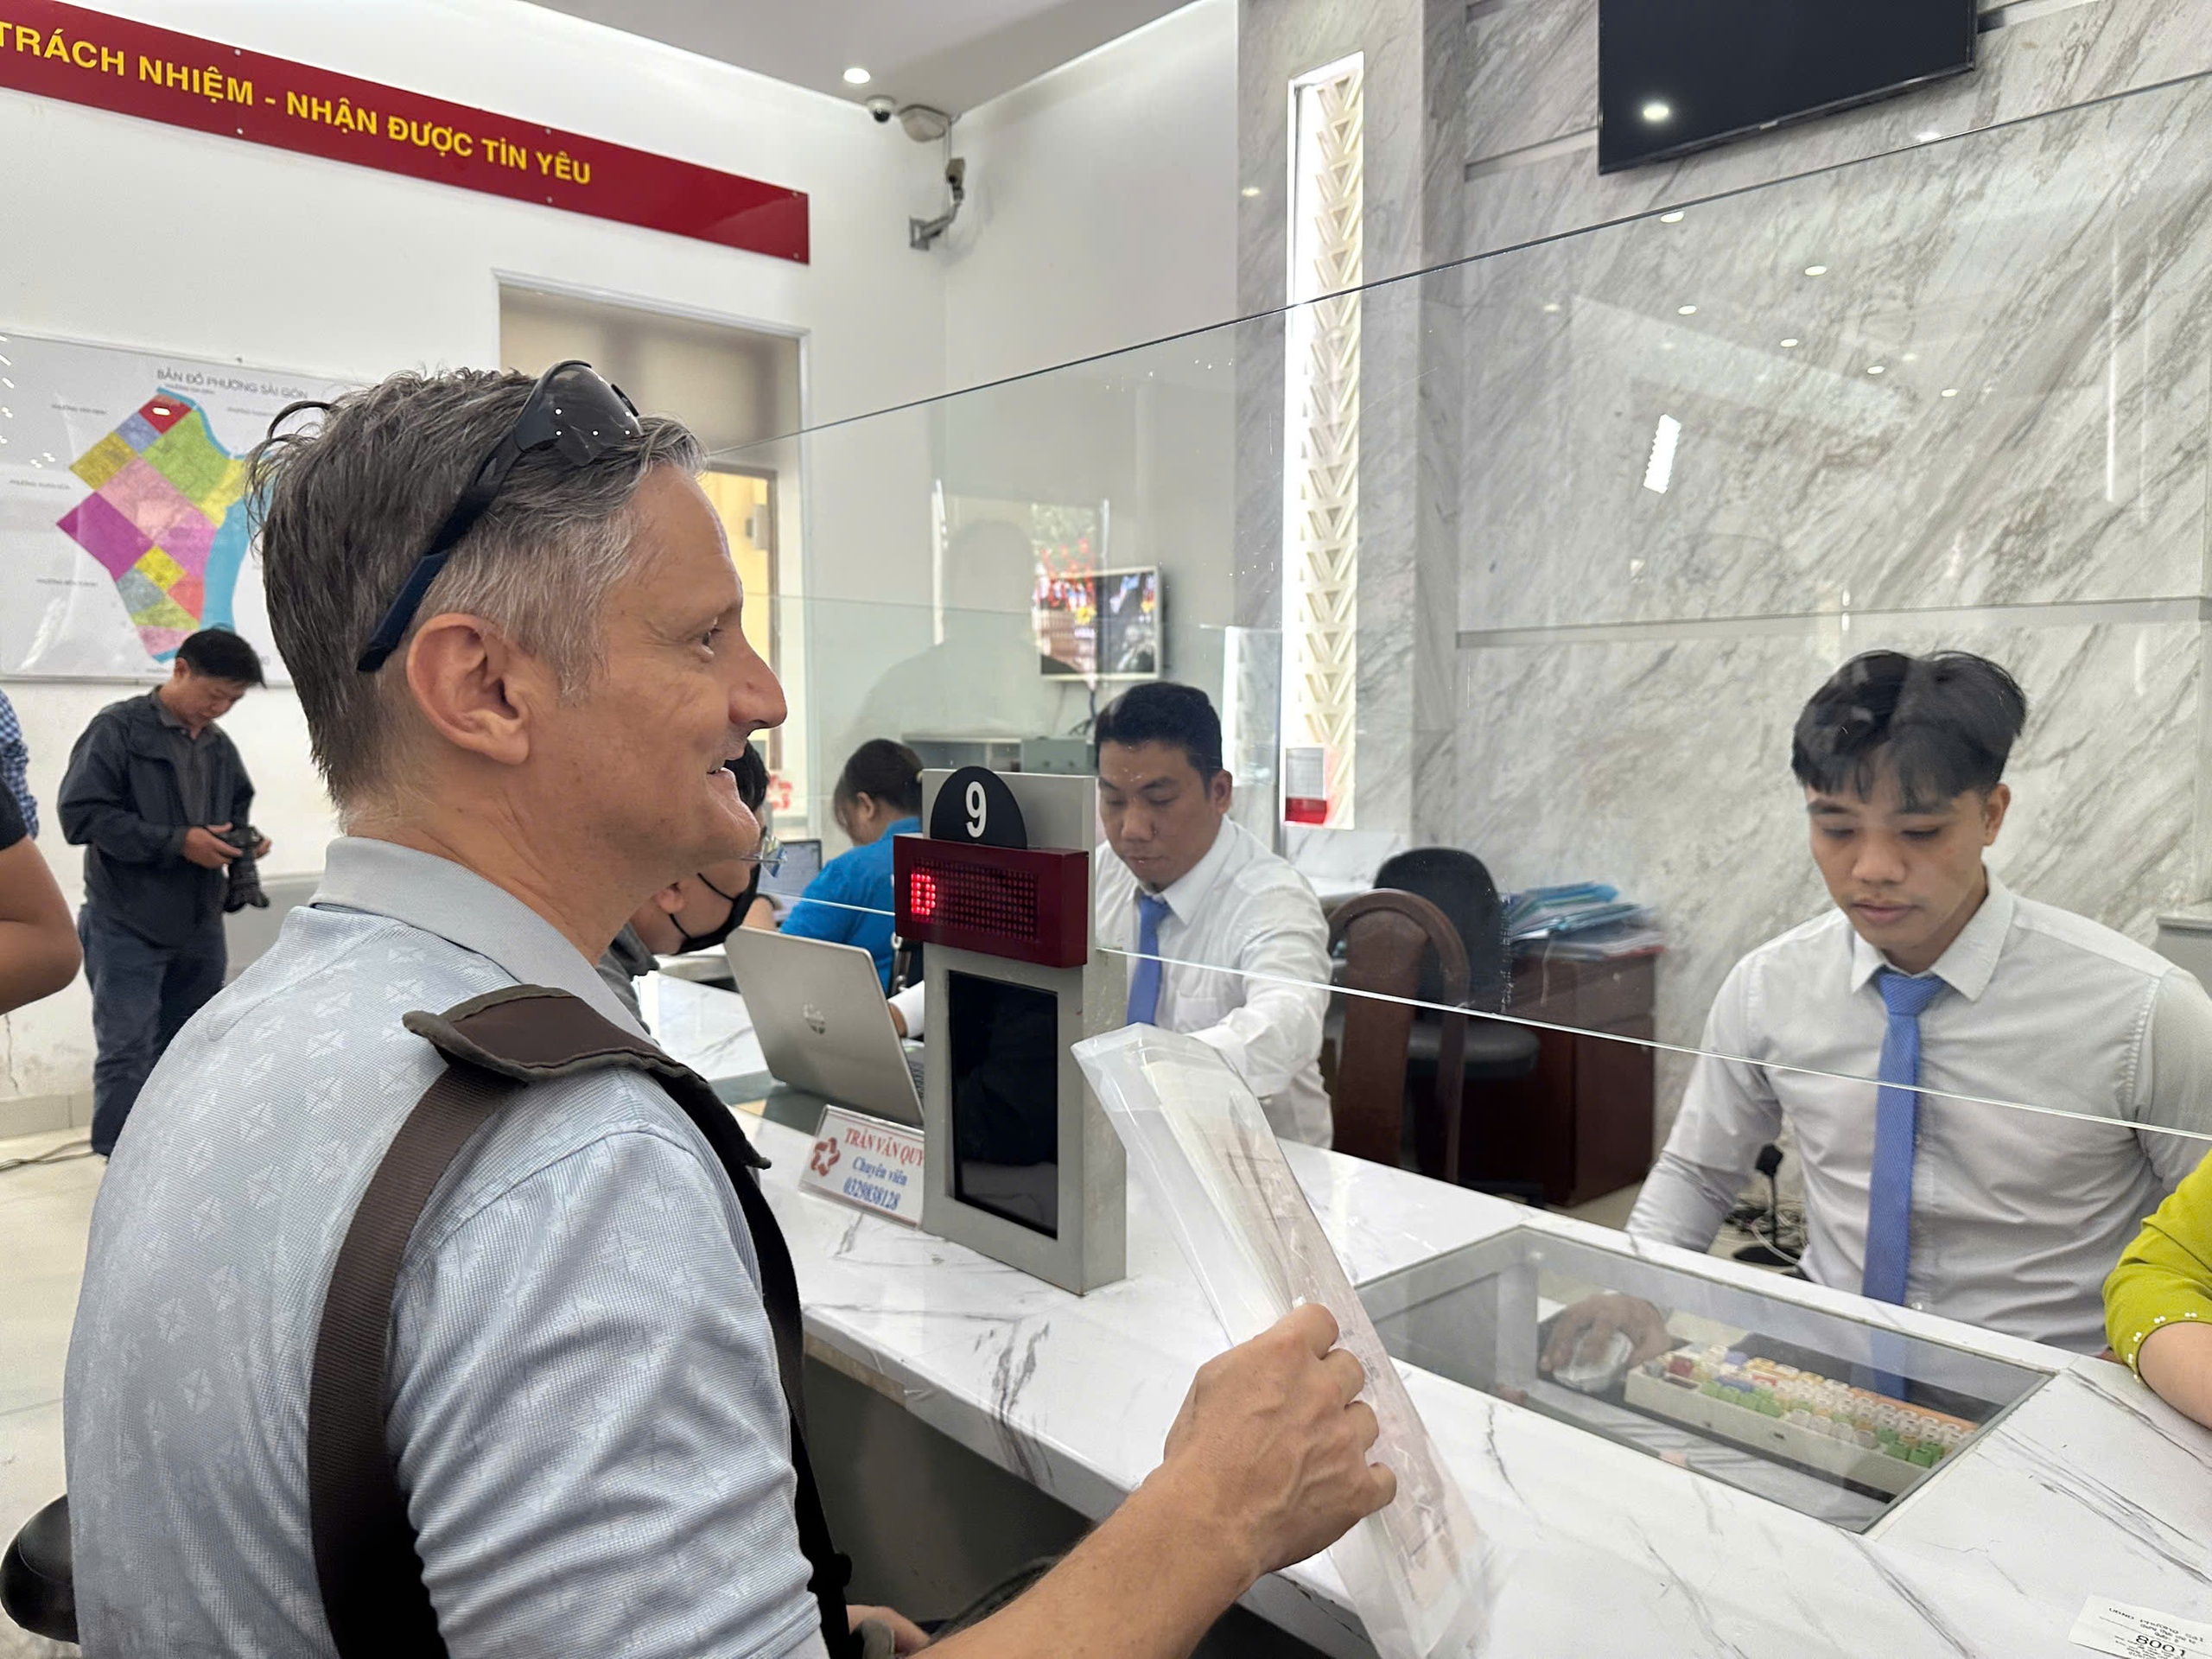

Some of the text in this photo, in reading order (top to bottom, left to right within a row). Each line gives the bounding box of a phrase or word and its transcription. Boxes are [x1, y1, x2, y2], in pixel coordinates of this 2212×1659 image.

[0, 21, 125, 76] TRÁCH
[138, 55, 254, 106] NHIỆM
[286, 91, 378, 135] NHẬN
[388, 116, 474, 157] ĐƯỢC
[534, 149, 591, 185] YÊU
[965, 780, 987, 838] 9
[2136, 1635, 2185, 1657] 8001
